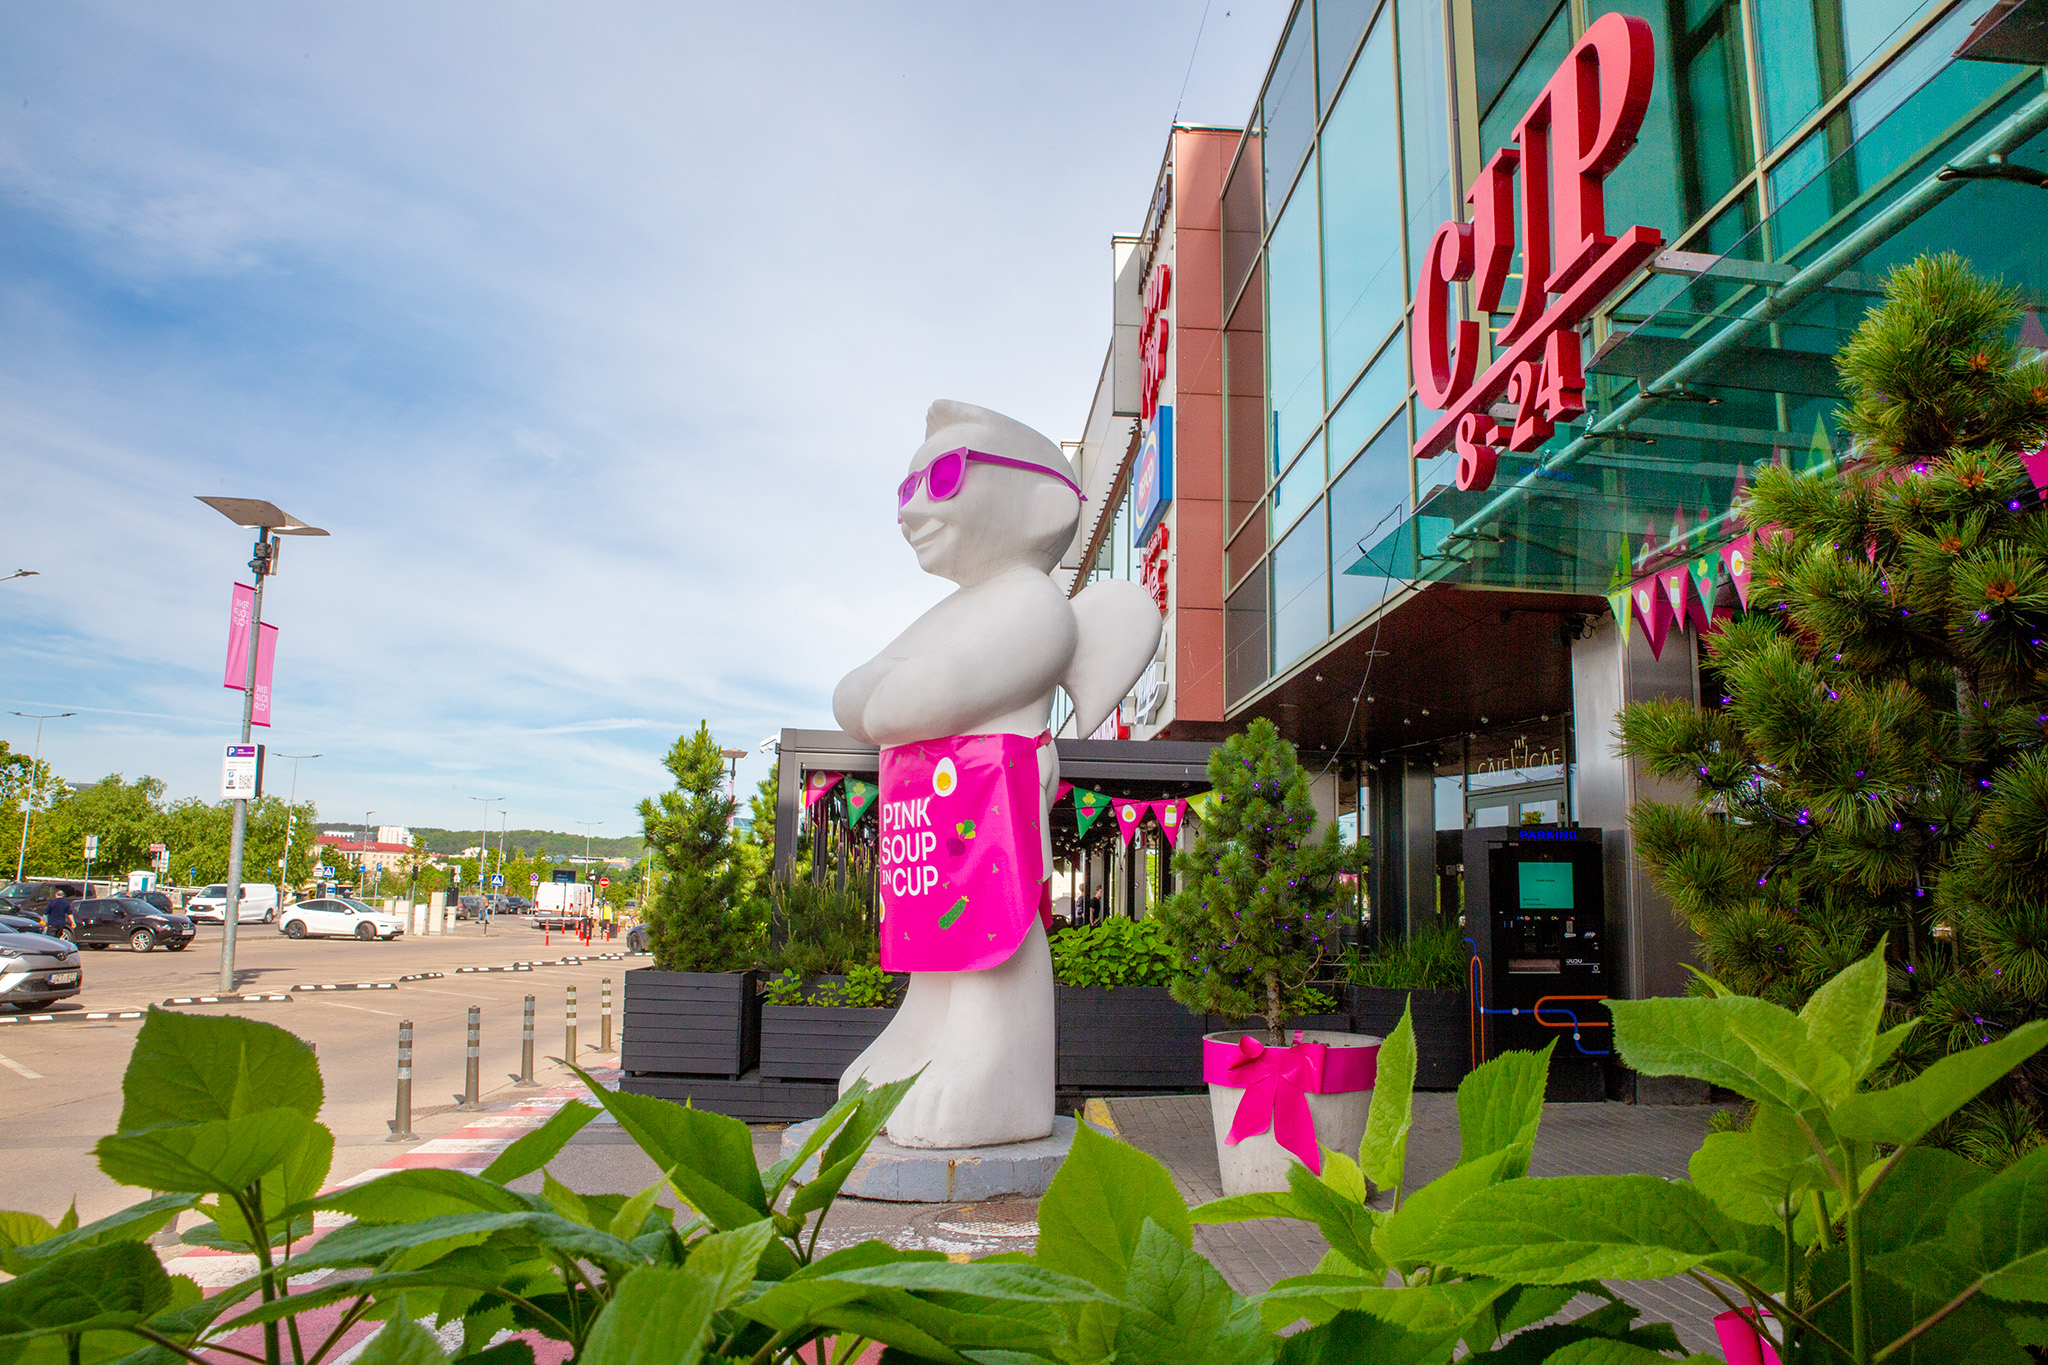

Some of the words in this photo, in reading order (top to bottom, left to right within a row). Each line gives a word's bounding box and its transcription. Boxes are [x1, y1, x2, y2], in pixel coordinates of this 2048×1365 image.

[1412, 12, 1654, 411] CUP
[1455, 330, 1585, 492] 8-24
[1477, 758, 1509, 780] CAIF
[883, 797, 932, 832] PINK
[882, 831, 937, 865] SOUP
[1519, 830, 1577, 840] PARKING
[882, 869, 892, 885] IN
[892, 865, 939, 897] CUP
